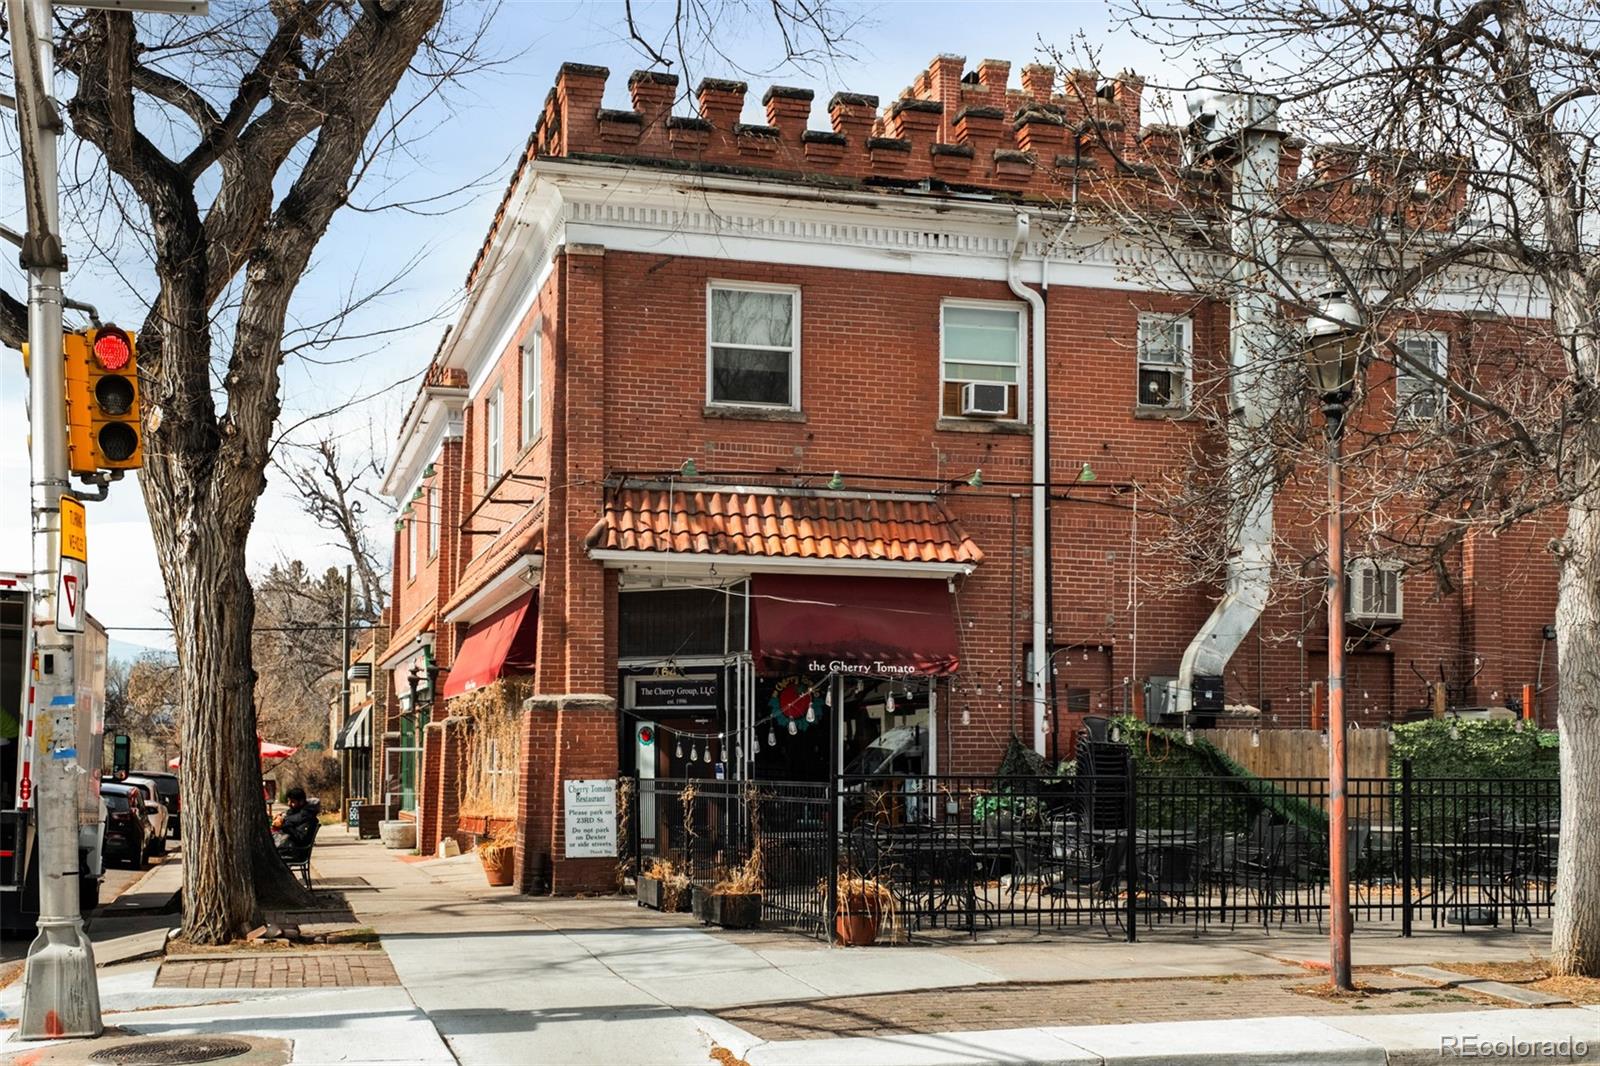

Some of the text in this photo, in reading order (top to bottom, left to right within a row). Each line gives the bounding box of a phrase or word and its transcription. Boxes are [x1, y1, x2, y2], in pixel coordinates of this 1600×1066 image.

[808, 660, 916, 673] the Cherry Tomato
[641, 686, 716, 697] The Cherry Group, LLC
[568, 784, 613, 794] Cherry Tomato
[575, 795, 606, 803] Restaurant
[589, 808, 603, 816] park
